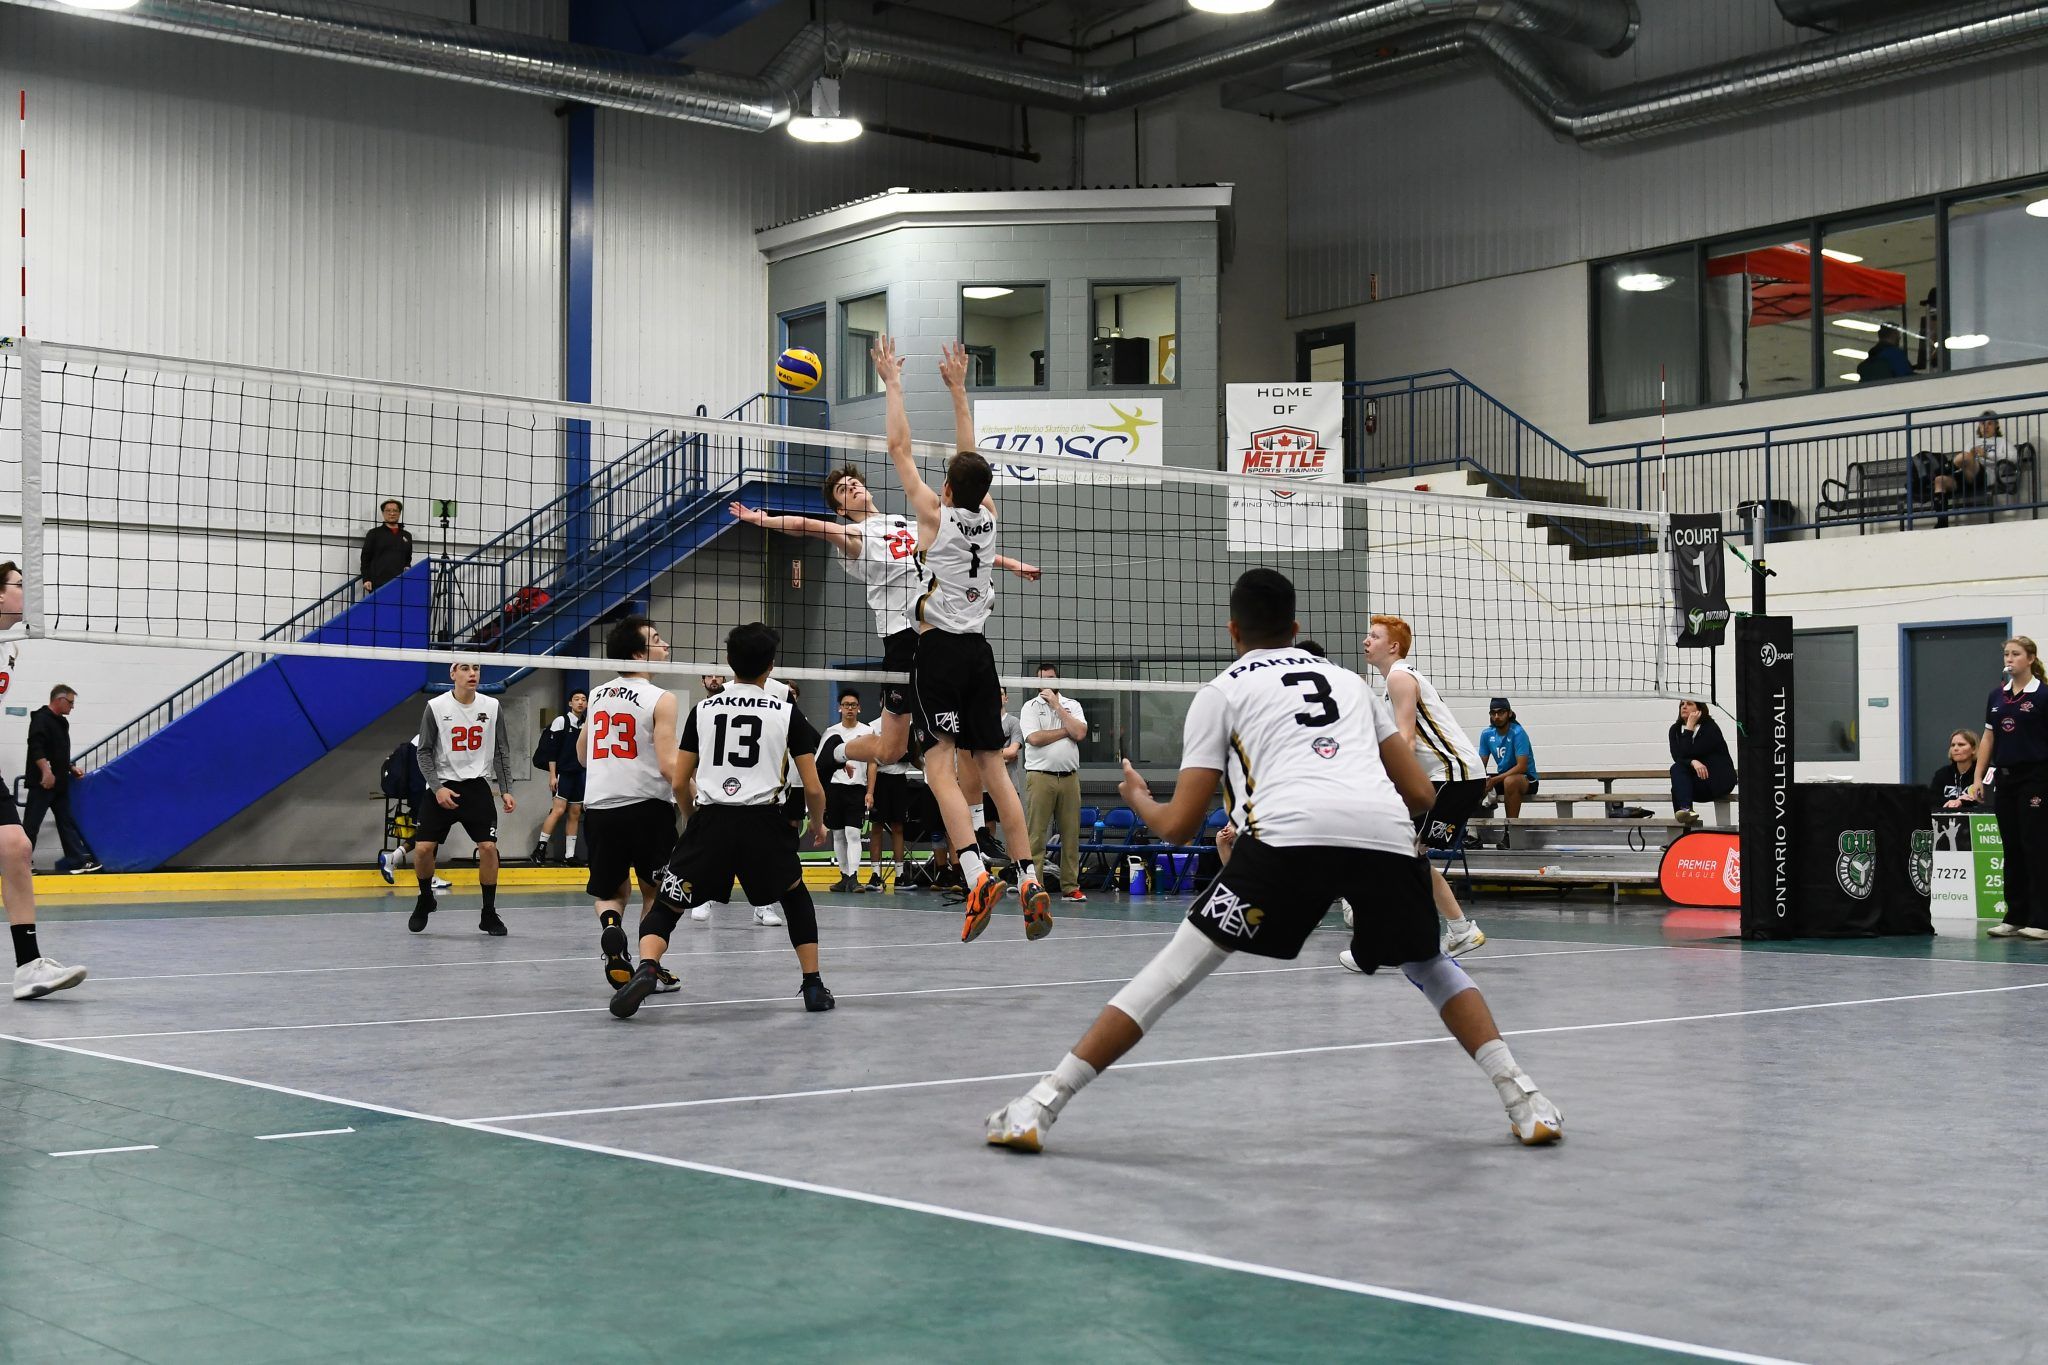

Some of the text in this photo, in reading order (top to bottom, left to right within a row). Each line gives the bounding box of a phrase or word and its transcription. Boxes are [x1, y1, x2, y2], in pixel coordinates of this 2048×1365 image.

[1257, 387, 1313, 398] HOME
[1273, 404, 1298, 415] OF
[1015, 424, 1043, 433] Waterloo
[1046, 424, 1070, 434] Skating
[1071, 424, 1086, 432] Club
[1241, 450, 1326, 474] METTLE
[1674, 528, 1719, 546] COURT
[968, 542, 981, 578] 1
[1692, 550, 1708, 594] 1
[1777, 652, 1794, 660] SPORT
[702, 696, 782, 711] PAKMEN
[1280, 671, 1341, 727] 3
[451, 725, 484, 751] 26
[592, 710, 639, 760] 23
[712, 713, 763, 769] 13
[1772, 686, 1788, 918] ONTARIO VOLLEYBALL
[1976, 823, 1998, 832] CAR
[1677, 859, 1717, 871] PREMIER
[1675, 871, 1716, 879] LEAGUE
